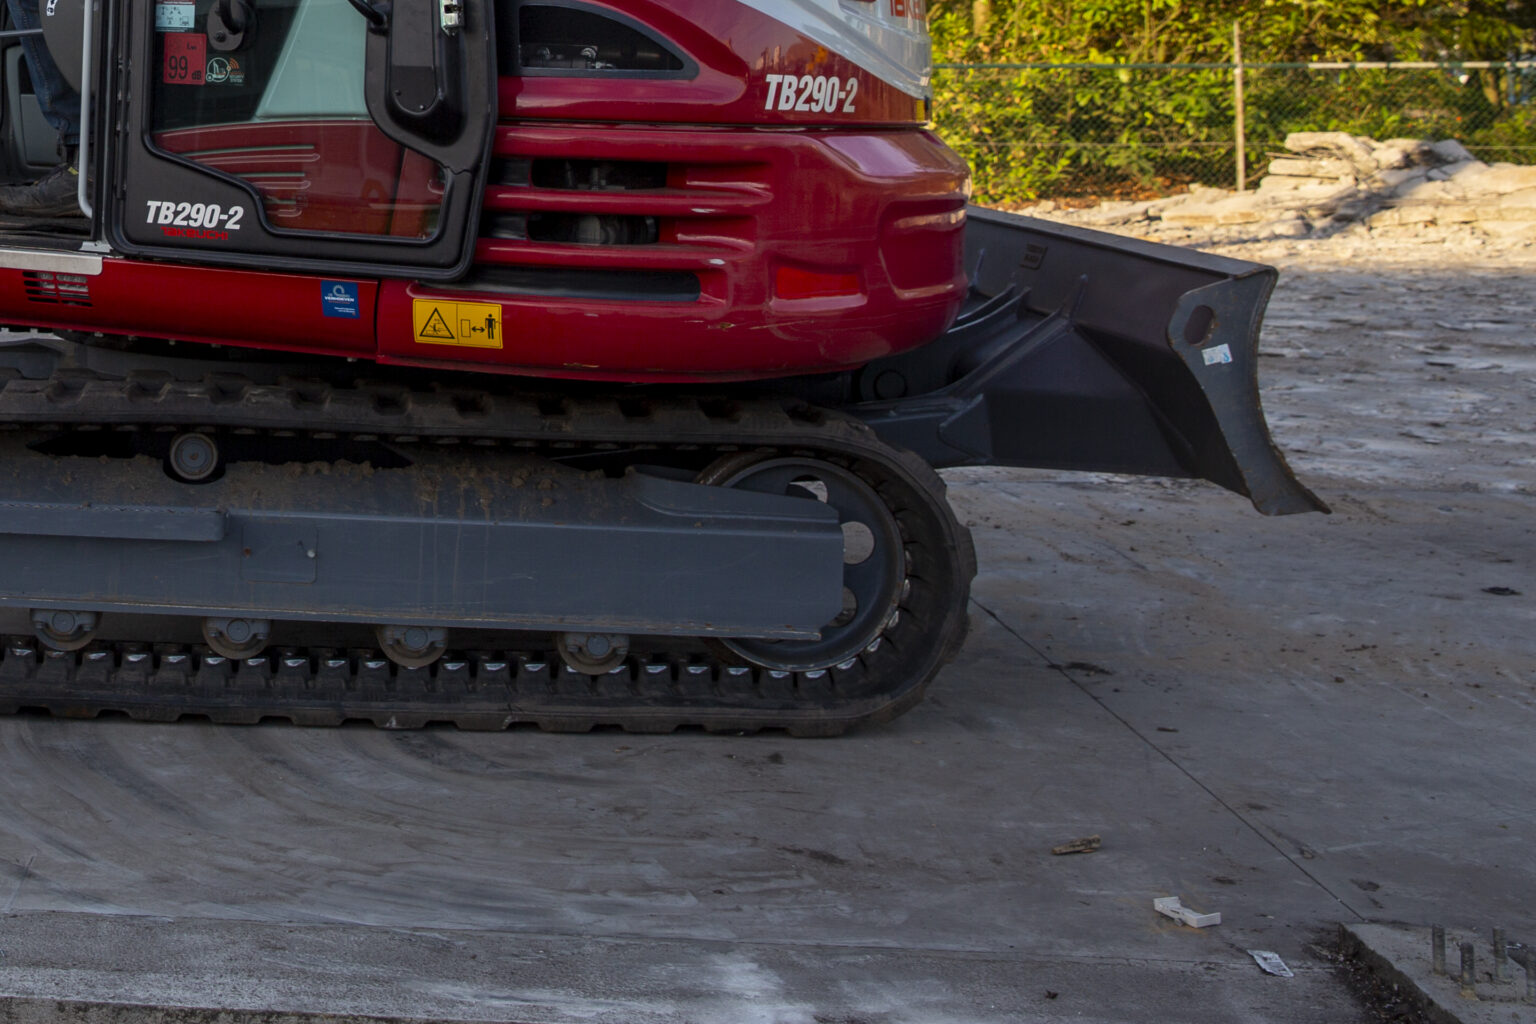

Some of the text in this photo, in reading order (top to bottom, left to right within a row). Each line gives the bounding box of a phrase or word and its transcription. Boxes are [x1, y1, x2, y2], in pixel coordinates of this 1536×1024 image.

[167, 56, 202, 80] 99 dB
[765, 74, 858, 113] TB290-2
[146, 200, 244, 230] TB290-2
[160, 226, 229, 241] TAKEUCHI
